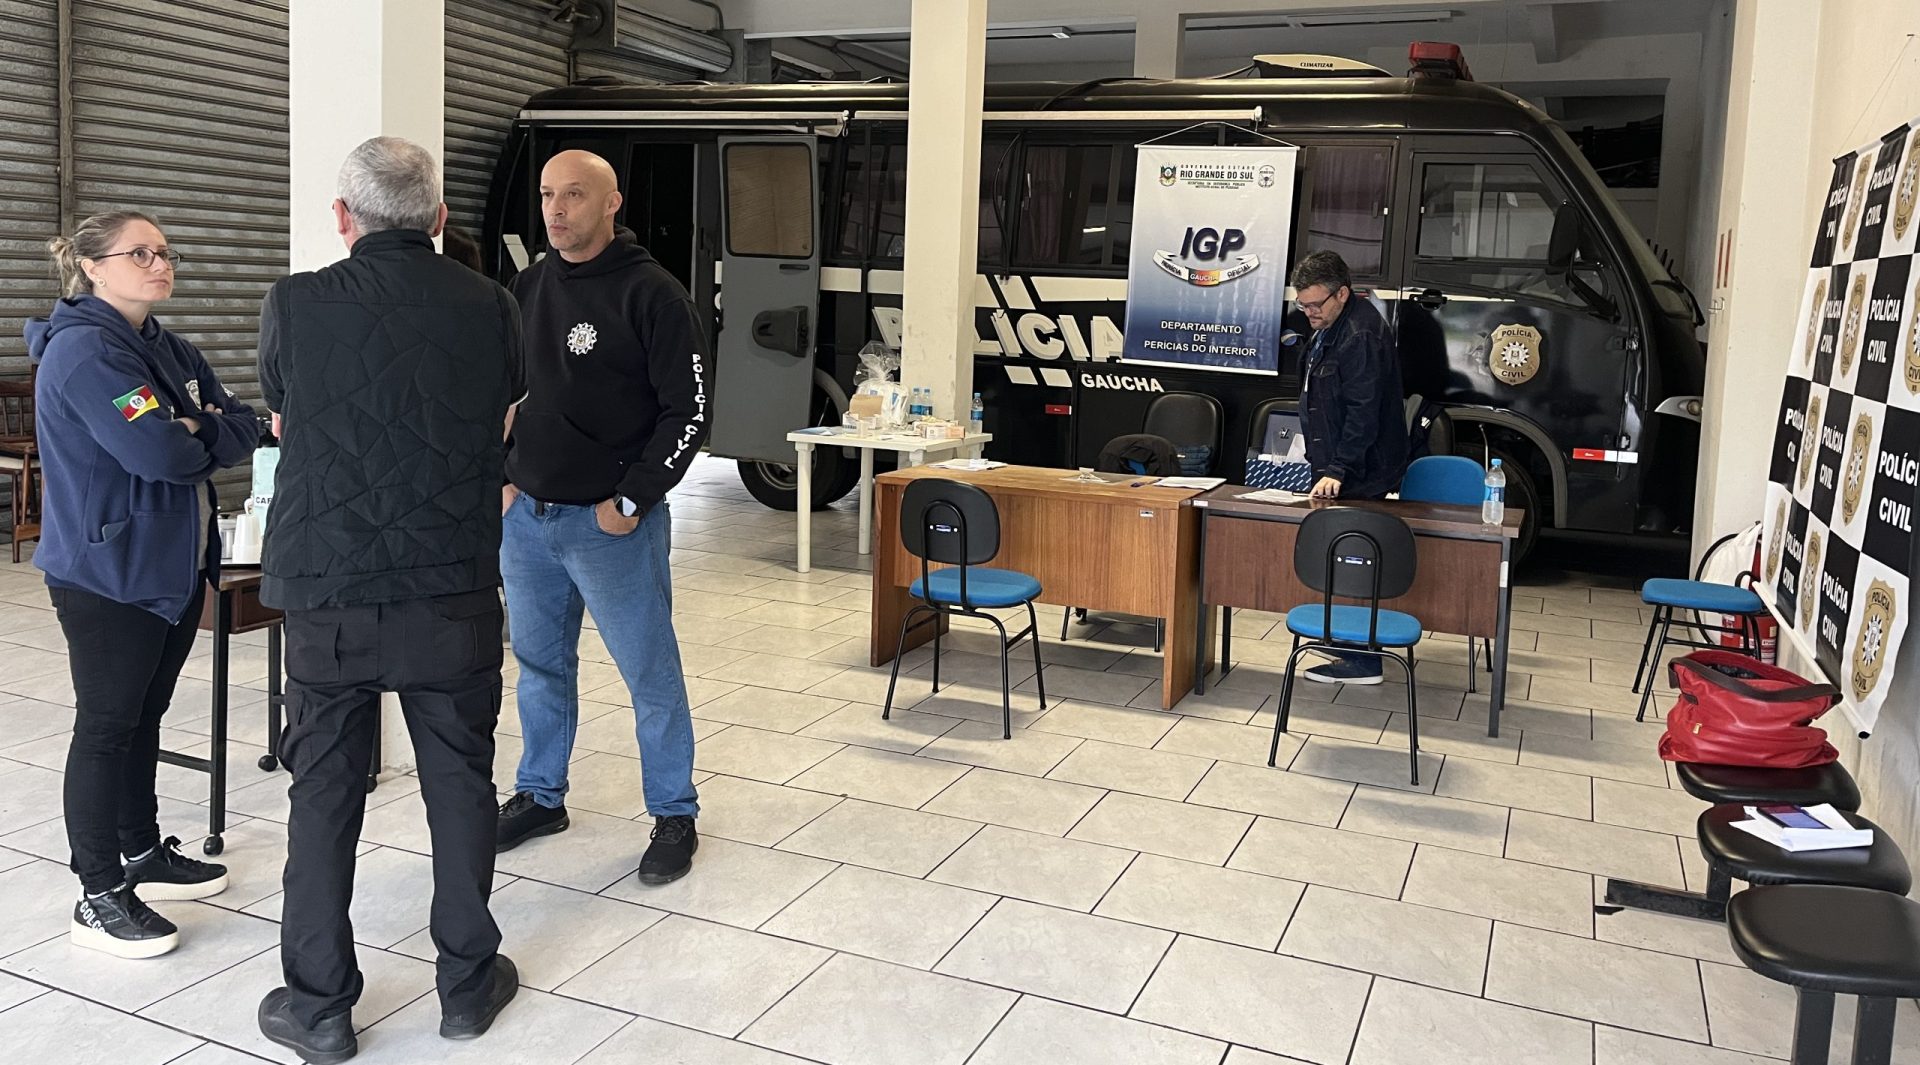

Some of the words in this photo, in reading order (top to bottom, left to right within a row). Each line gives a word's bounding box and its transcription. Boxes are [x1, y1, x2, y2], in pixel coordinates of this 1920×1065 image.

[1180, 170, 1193, 178] RIO
[1195, 171, 1225, 179] GRANDE
[1227, 171, 1238, 179] DO
[1180, 226, 1246, 261] IGP
[1869, 294, 1901, 322] POLÍCIA
[1161, 320, 1242, 334] DEPARTAMENTO
[1193, 333, 1207, 343] DE
[1502, 328, 1532, 338] POLÍCIA
[1191, 343, 1206, 353] DO
[1208, 344, 1257, 356] INTERIOR
[1867, 339, 1887, 363] CIVIL
[1081, 373, 1165, 393] GAÚCHA
[1501, 370, 1527, 378] CIVIL
[664, 424, 698, 470] CIVIL
[1821, 425, 1844, 454] POLÍCIA
[1819, 463, 1834, 490] CIVIL
[1878, 451, 1920, 487] POLÍCI
[255, 496, 273, 504] CAF
[1879, 497, 1912, 533] CIVIL
[1785, 531, 1803, 563] POLÍCIA
[1782, 567, 1795, 594] CIVIL
[1822, 571, 1849, 614] POLÍCIA
[1822, 614, 1837, 650] CIVIL
[1854, 673, 1867, 691] CIVIL
